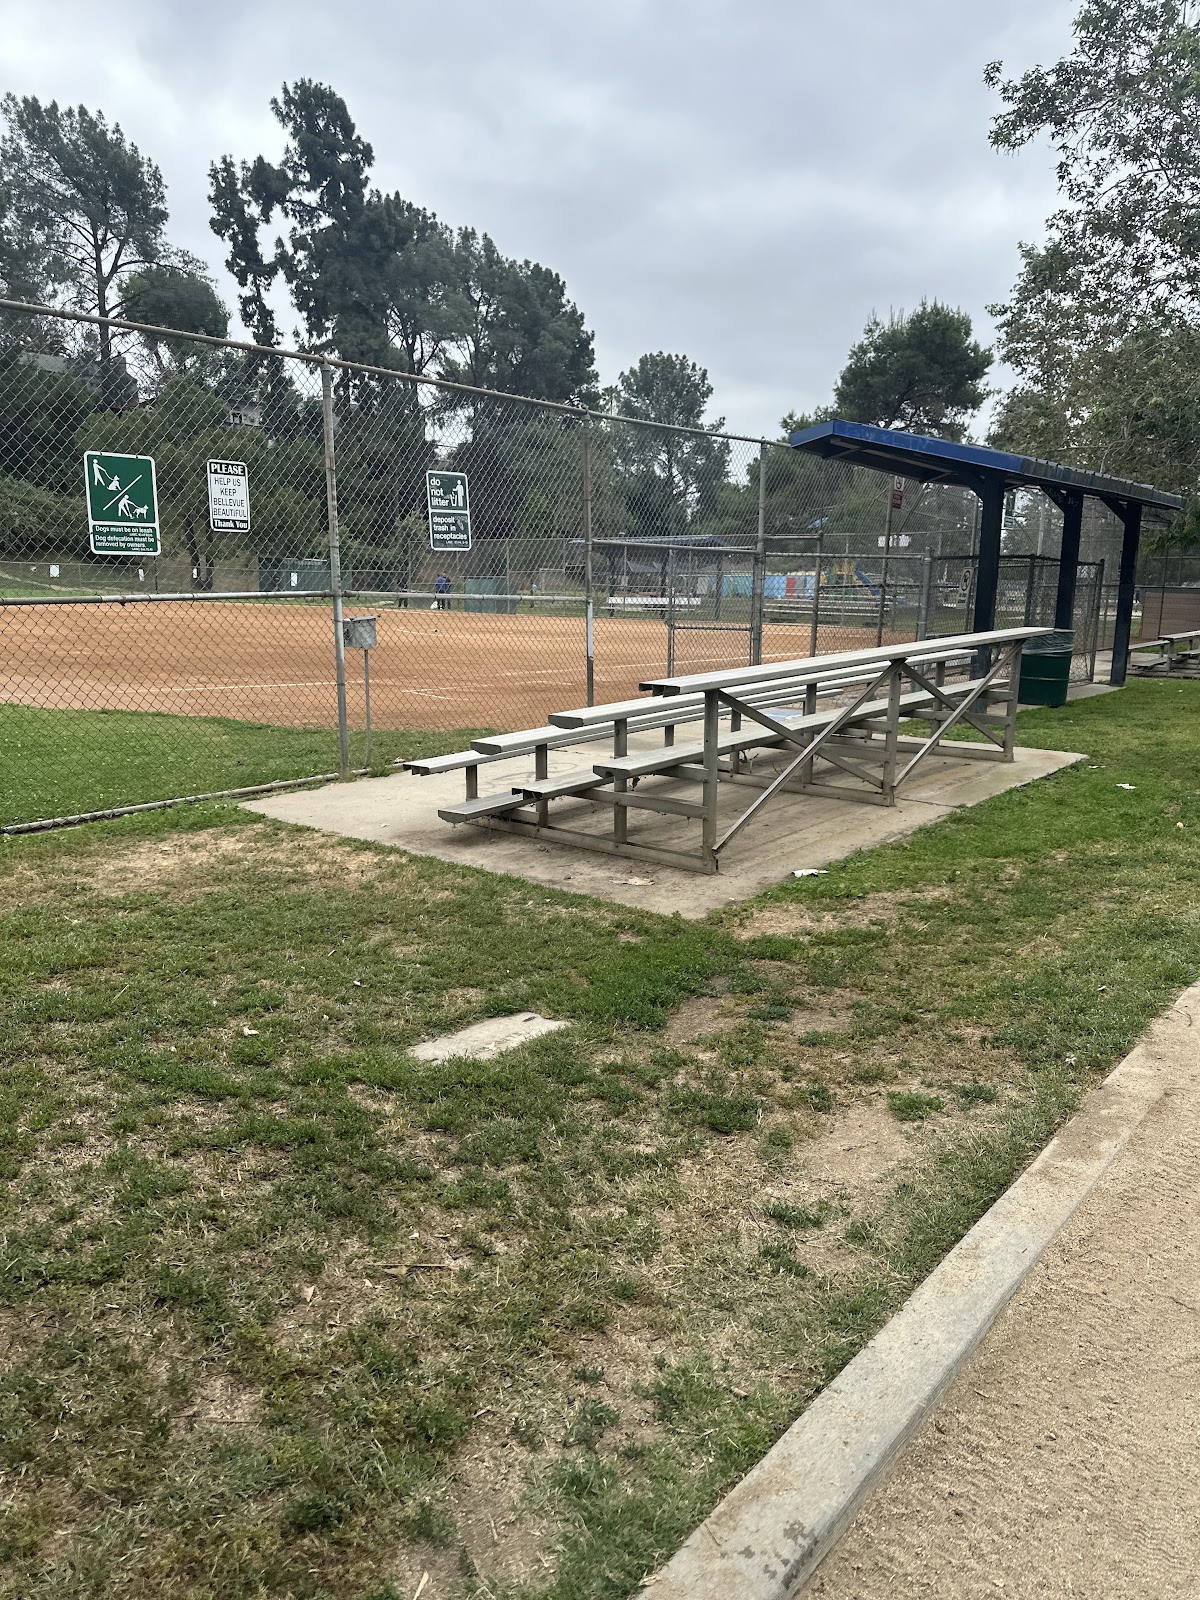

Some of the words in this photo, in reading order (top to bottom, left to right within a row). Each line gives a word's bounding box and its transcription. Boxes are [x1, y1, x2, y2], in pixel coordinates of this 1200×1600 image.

[211, 464, 244, 475] PLEASE
[214, 477, 231, 485] HELP
[430, 477, 440, 486] do
[220, 488, 236, 496] KEEP
[431, 488, 444, 496] not
[214, 498, 244, 507] BELLEVUE
[431, 497, 449, 506] litter
[214, 508, 246, 517] BEAUTIFUL
[433, 516, 455, 524] deposit
